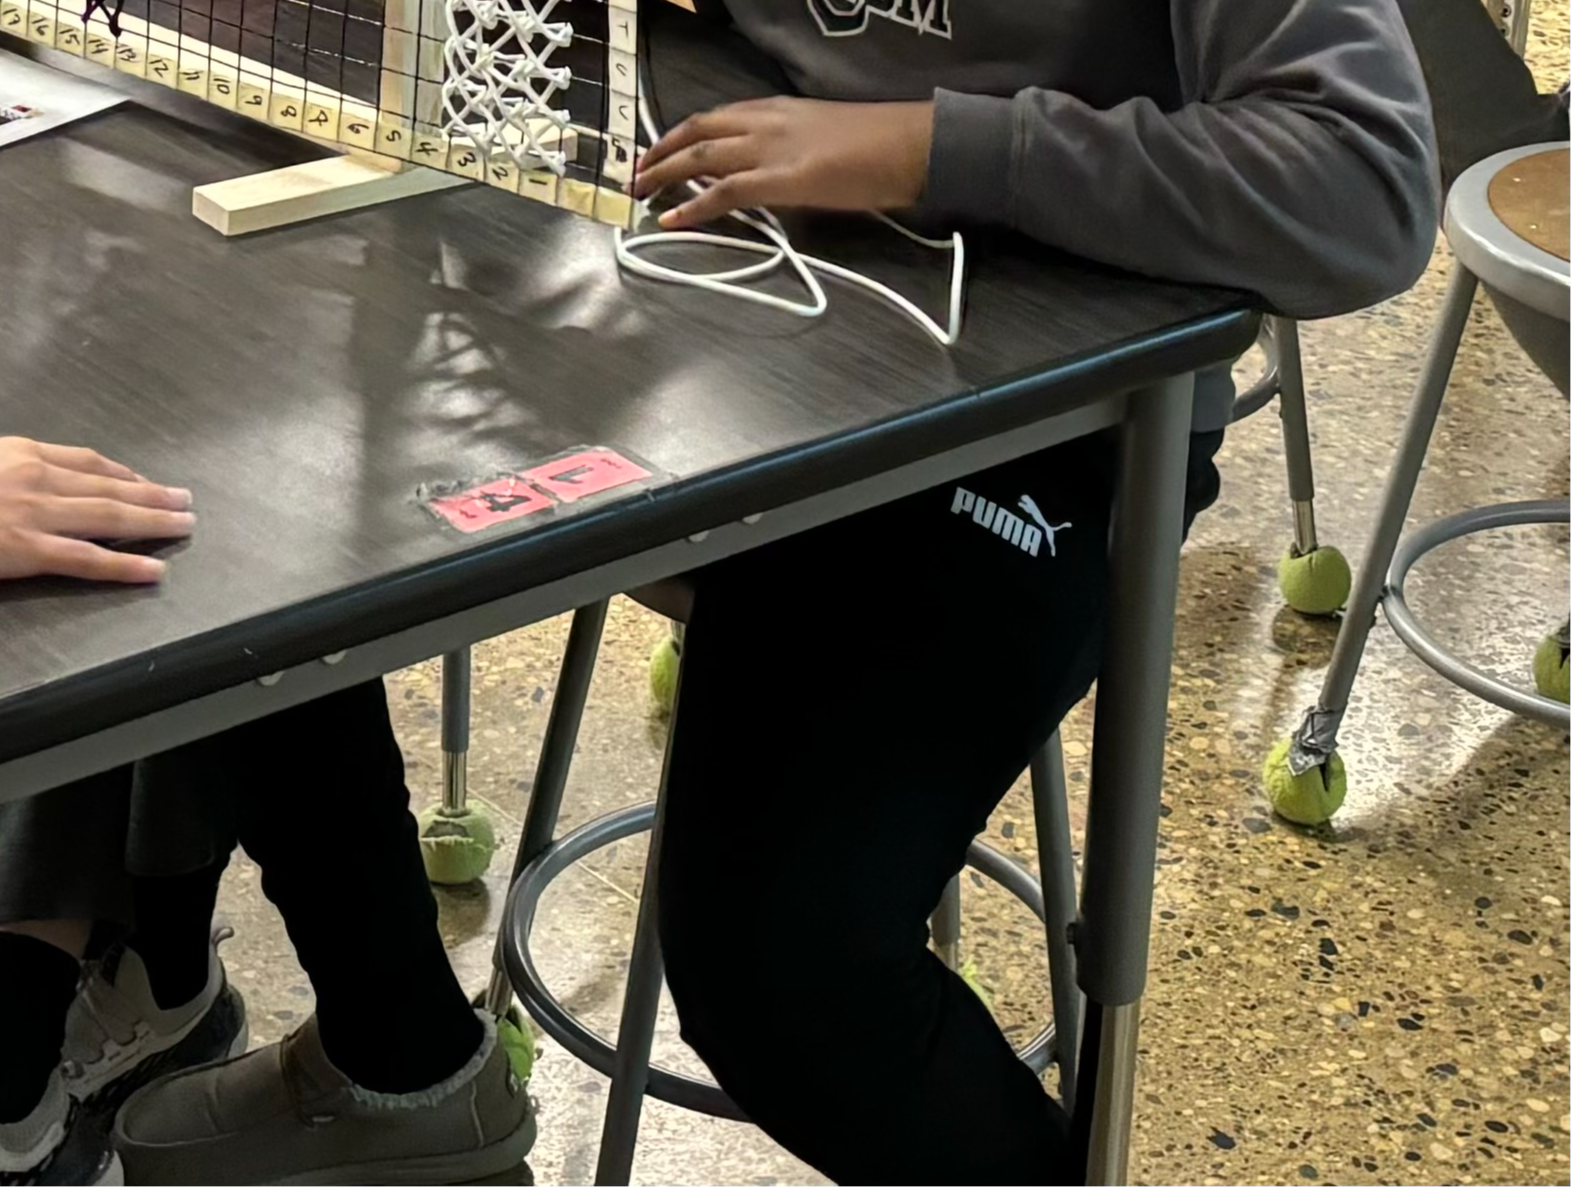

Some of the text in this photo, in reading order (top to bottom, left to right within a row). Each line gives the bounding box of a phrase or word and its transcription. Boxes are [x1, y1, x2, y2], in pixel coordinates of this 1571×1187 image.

[615, 21, 630, 40] T
[614, 62, 629, 78] U
[2, 5, 21, 26] 17
[31, 15, 50, 37] 16
[59, 25, 81, 46] 15
[87, 38, 110, 56] 14
[116, 44, 137, 64] 13
[149, 58, 170, 79] 12
[213, 76, 231, 96] 10
[244, 93, 263, 107] 9
[280, 104, 298, 119] 8
[347, 122, 370, 135] 6
[385, 130, 402, 144] 5
[415, 141, 439, 157] 4
[456, 151, 477, 168] 3
[492, 165, 509, 181] 2
[527, 177, 548, 186] 1
[950, 486, 1043, 558] PUMA
